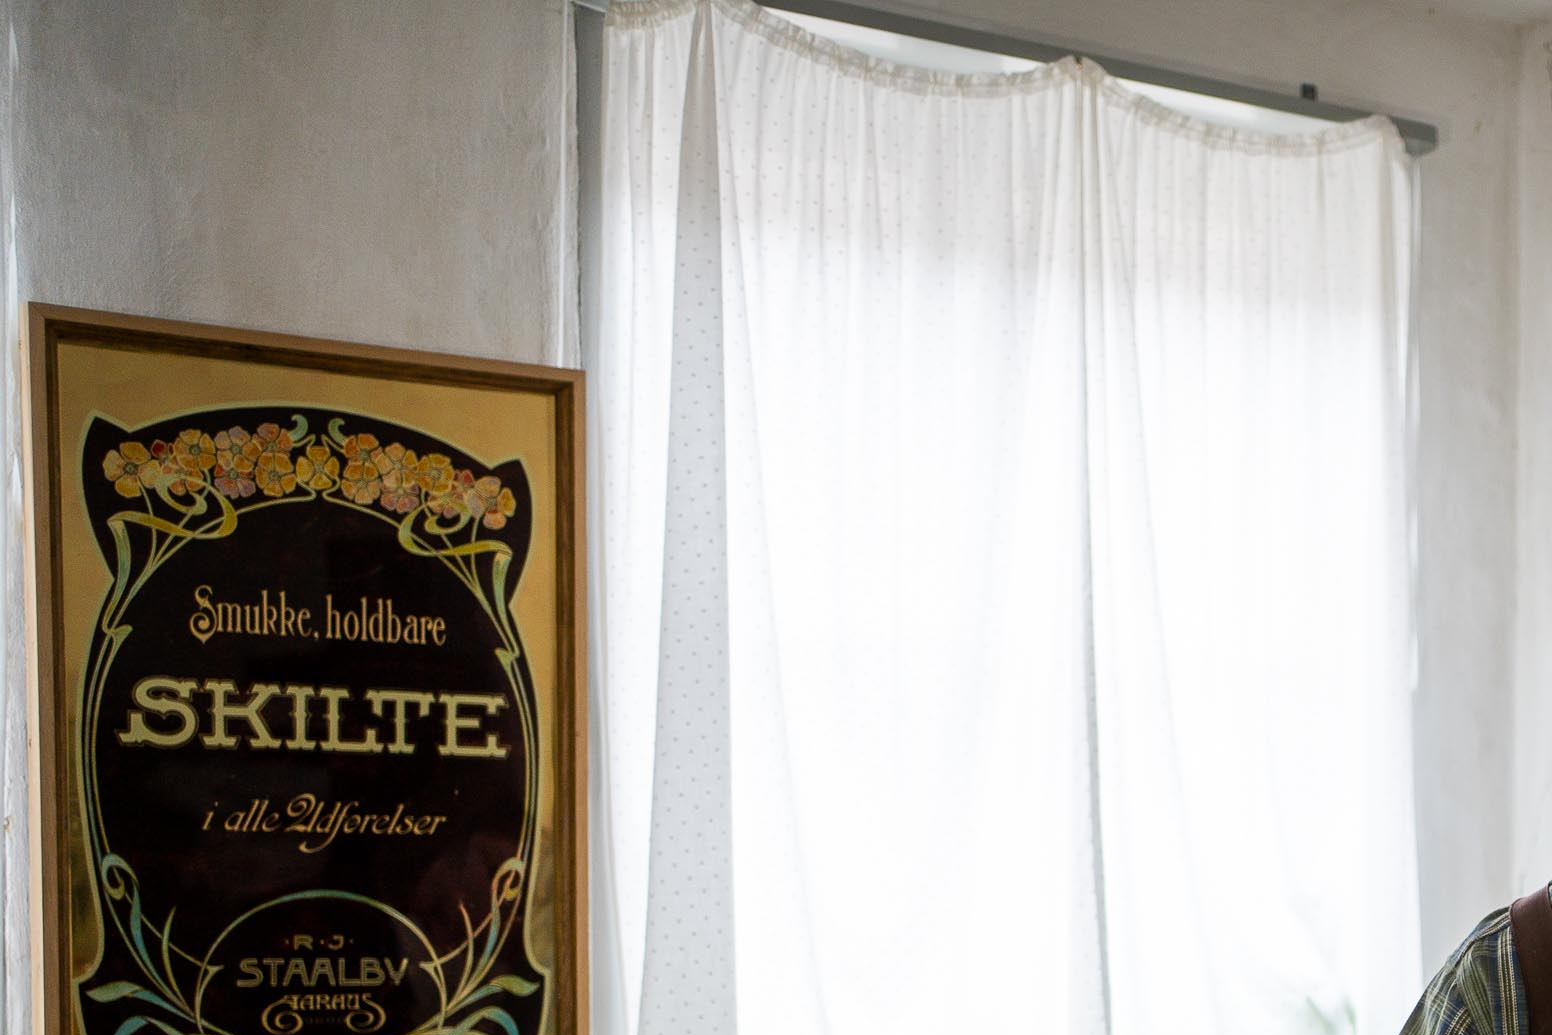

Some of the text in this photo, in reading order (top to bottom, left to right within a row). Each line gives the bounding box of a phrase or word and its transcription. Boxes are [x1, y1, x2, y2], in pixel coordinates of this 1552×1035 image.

[325, 594, 447, 646] holdbare
[115, 676, 509, 758] SKILTE
[202, 801, 219, 831] i
[223, 798, 281, 833] alle
